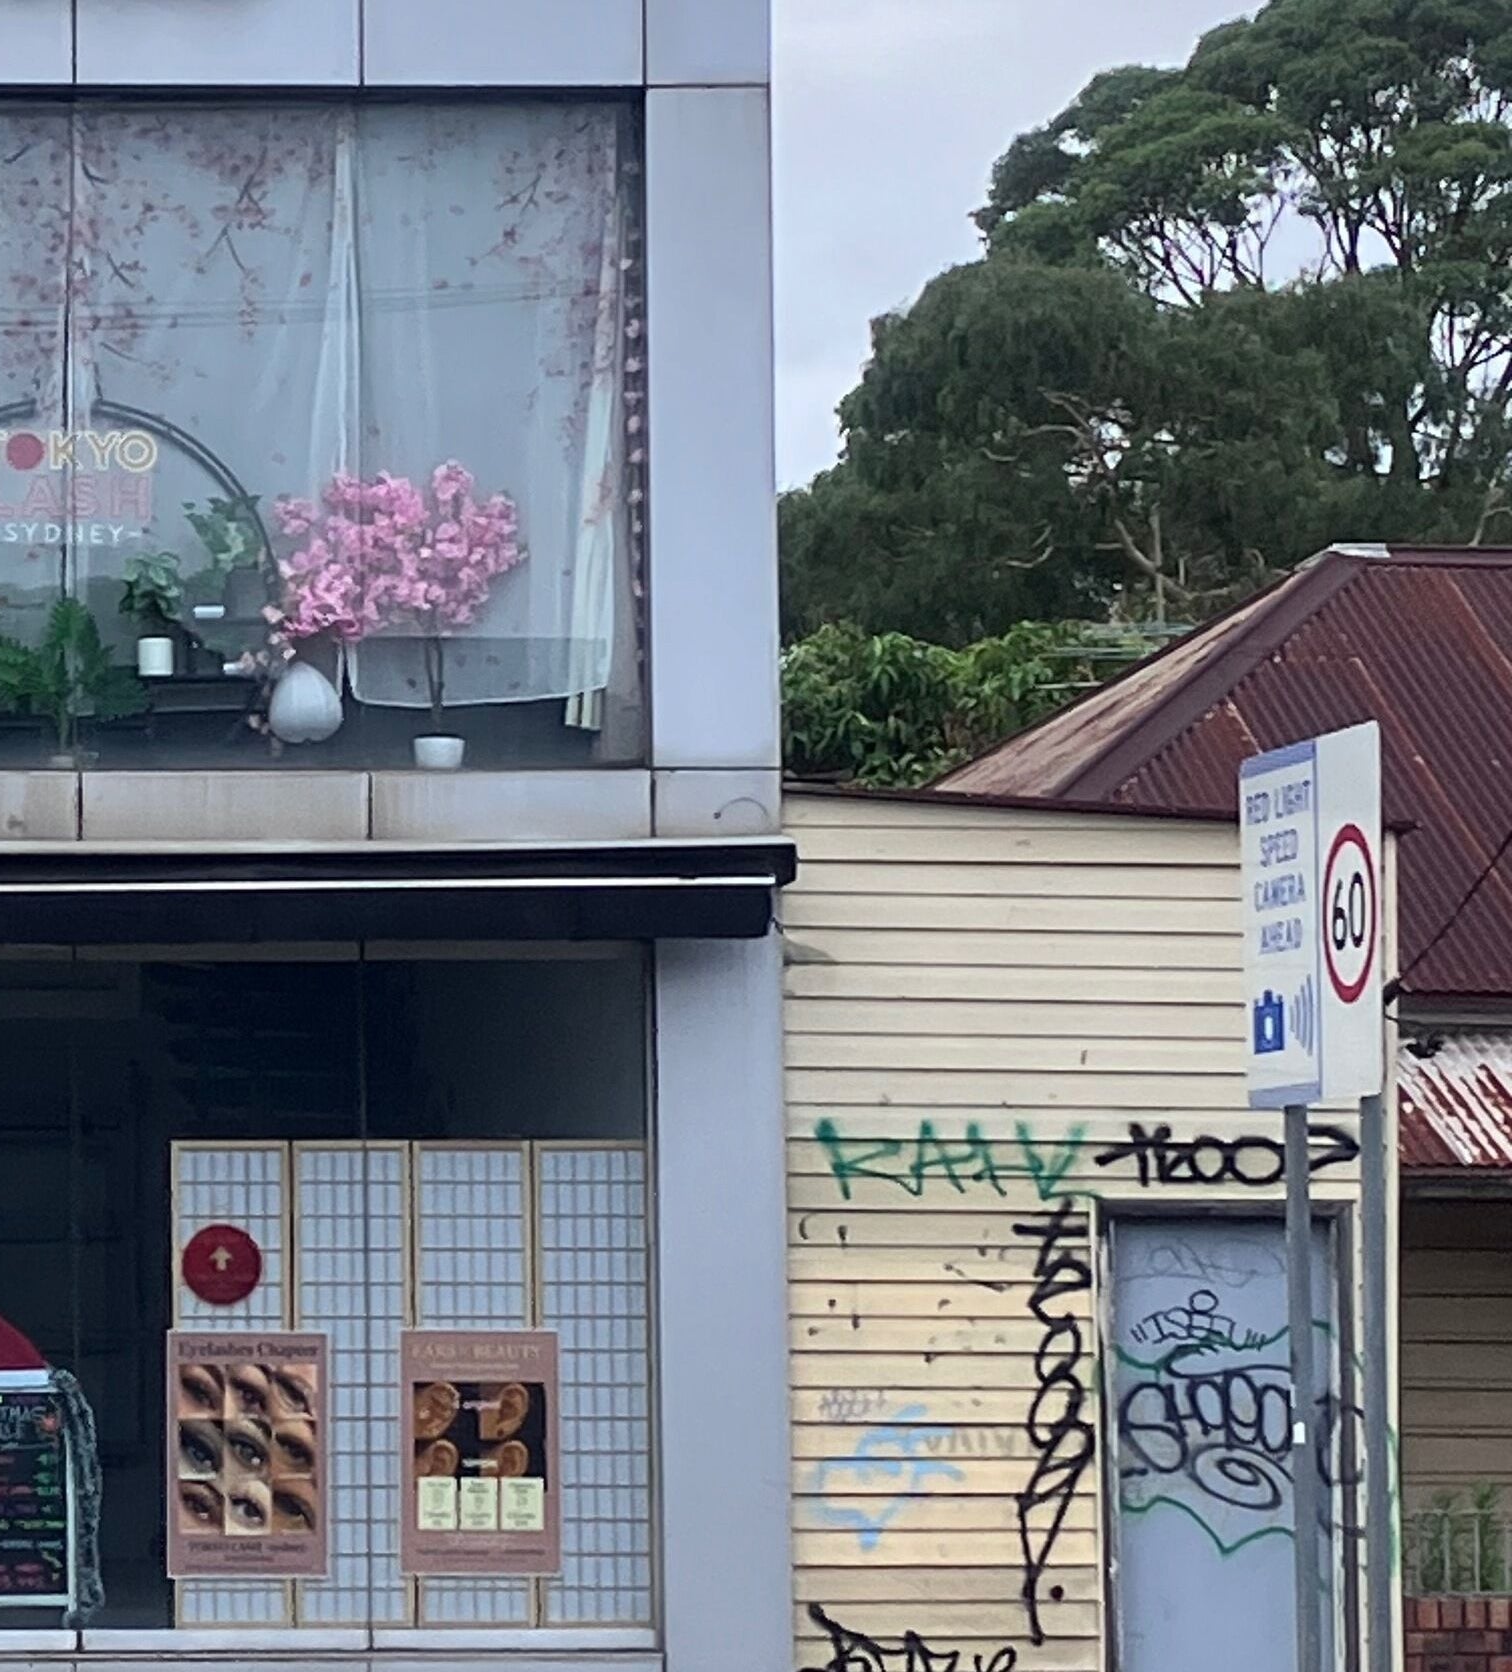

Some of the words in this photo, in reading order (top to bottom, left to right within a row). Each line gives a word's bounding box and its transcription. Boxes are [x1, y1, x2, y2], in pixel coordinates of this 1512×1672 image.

[1246, 791, 1270, 826] RED
[1274, 779, 1311, 820] LIGHT
[1260, 828, 1300, 868] SPEED
[1253, 872, 1307, 912] CAMERA
[1331, 870, 1367, 951] 60
[1258, 917, 1304, 956] AHEAD
[473, 1343, 541, 1359] BEAUTY
